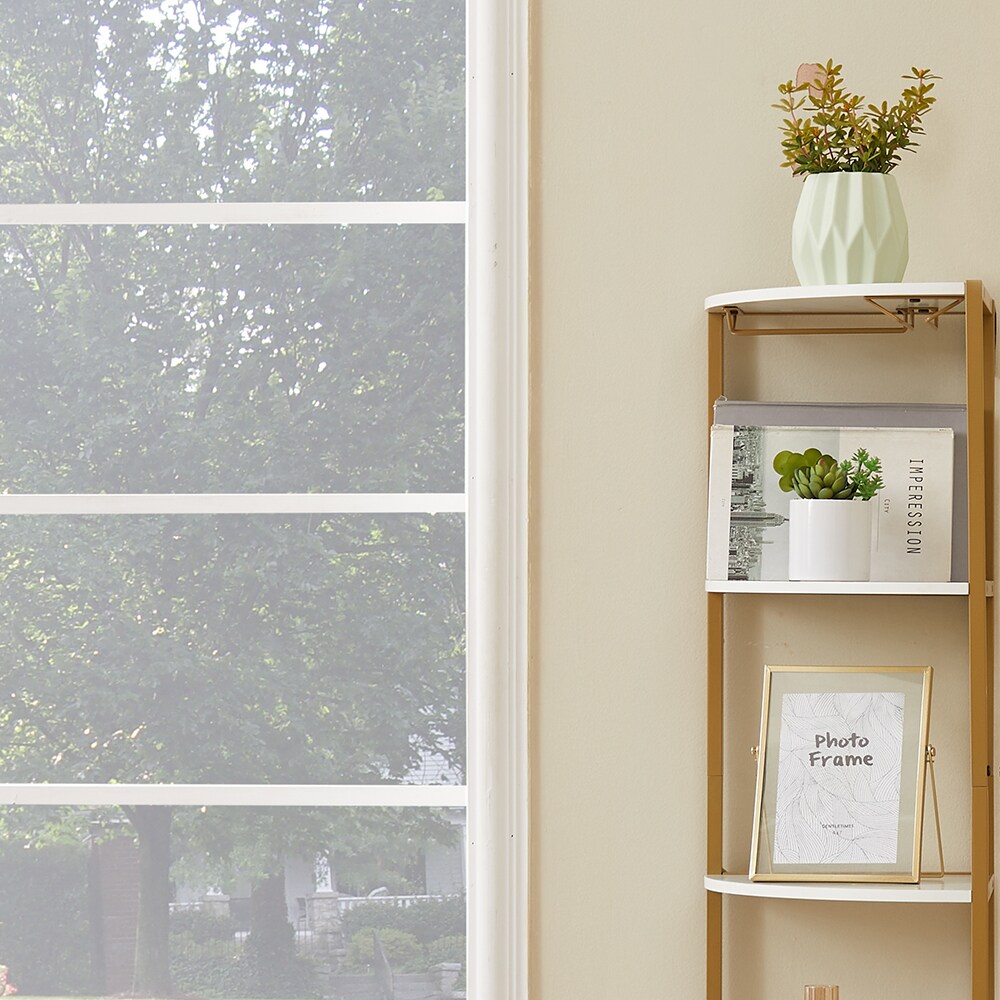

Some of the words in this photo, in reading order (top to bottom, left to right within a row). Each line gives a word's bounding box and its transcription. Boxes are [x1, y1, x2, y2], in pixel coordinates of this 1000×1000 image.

[906, 459, 924, 554] IMPERESSION
[815, 732, 869, 748] Photo
[809, 751, 873, 767] Frame
